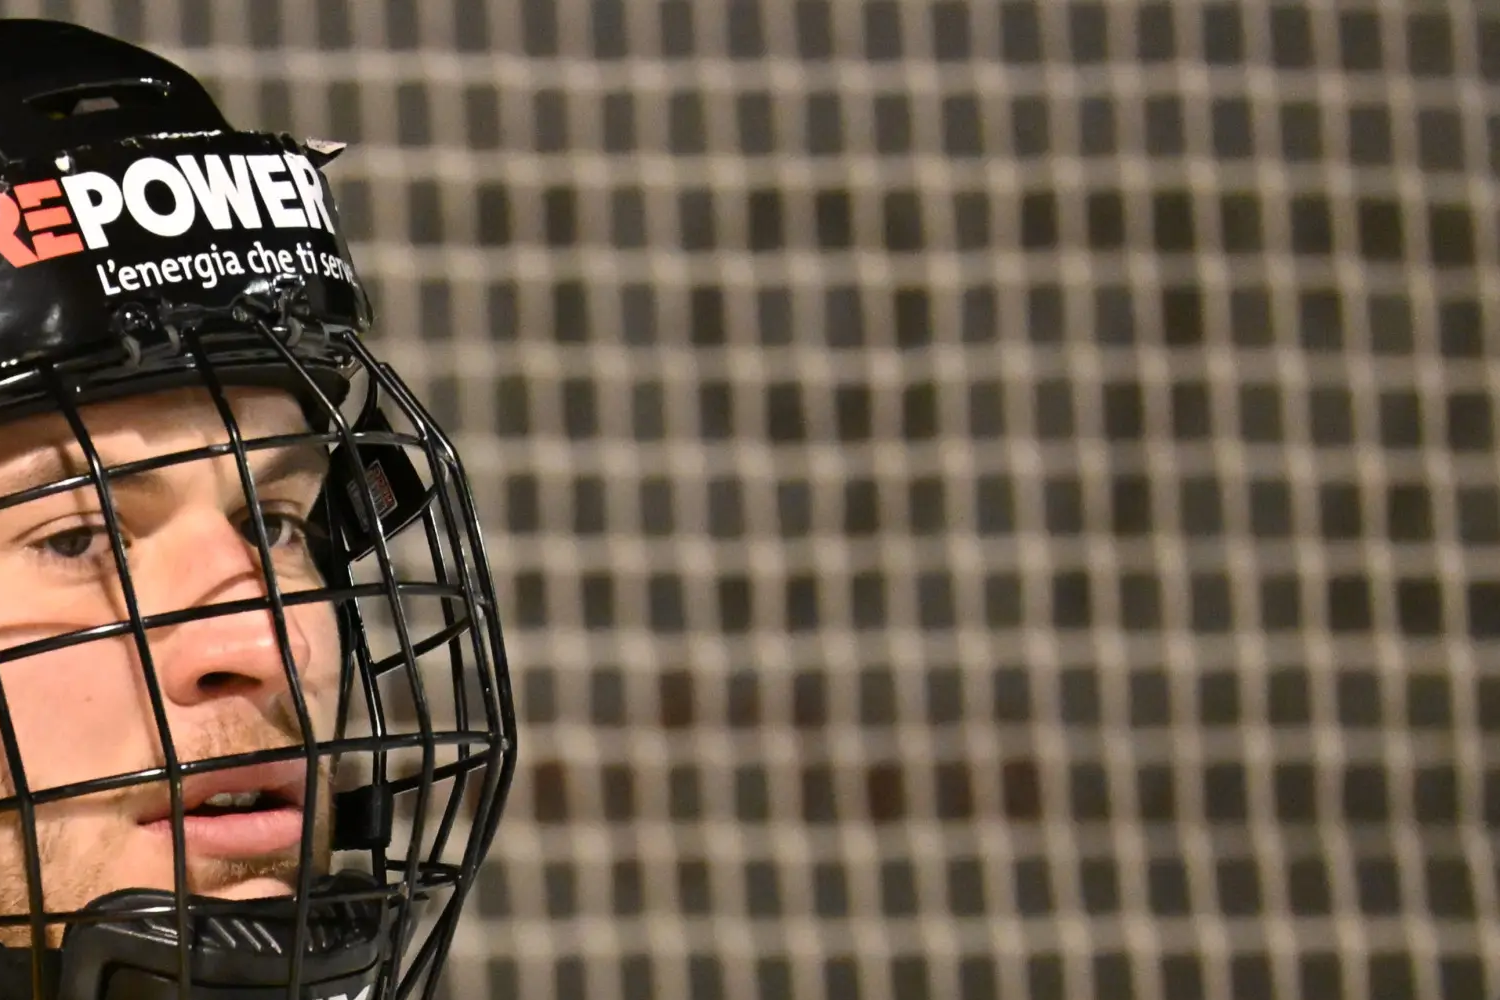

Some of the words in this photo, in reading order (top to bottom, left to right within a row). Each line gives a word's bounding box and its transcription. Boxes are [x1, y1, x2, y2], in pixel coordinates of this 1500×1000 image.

[96, 244, 245, 296] L'energia
[246, 240, 296, 274] che
[296, 241, 319, 275] ti
